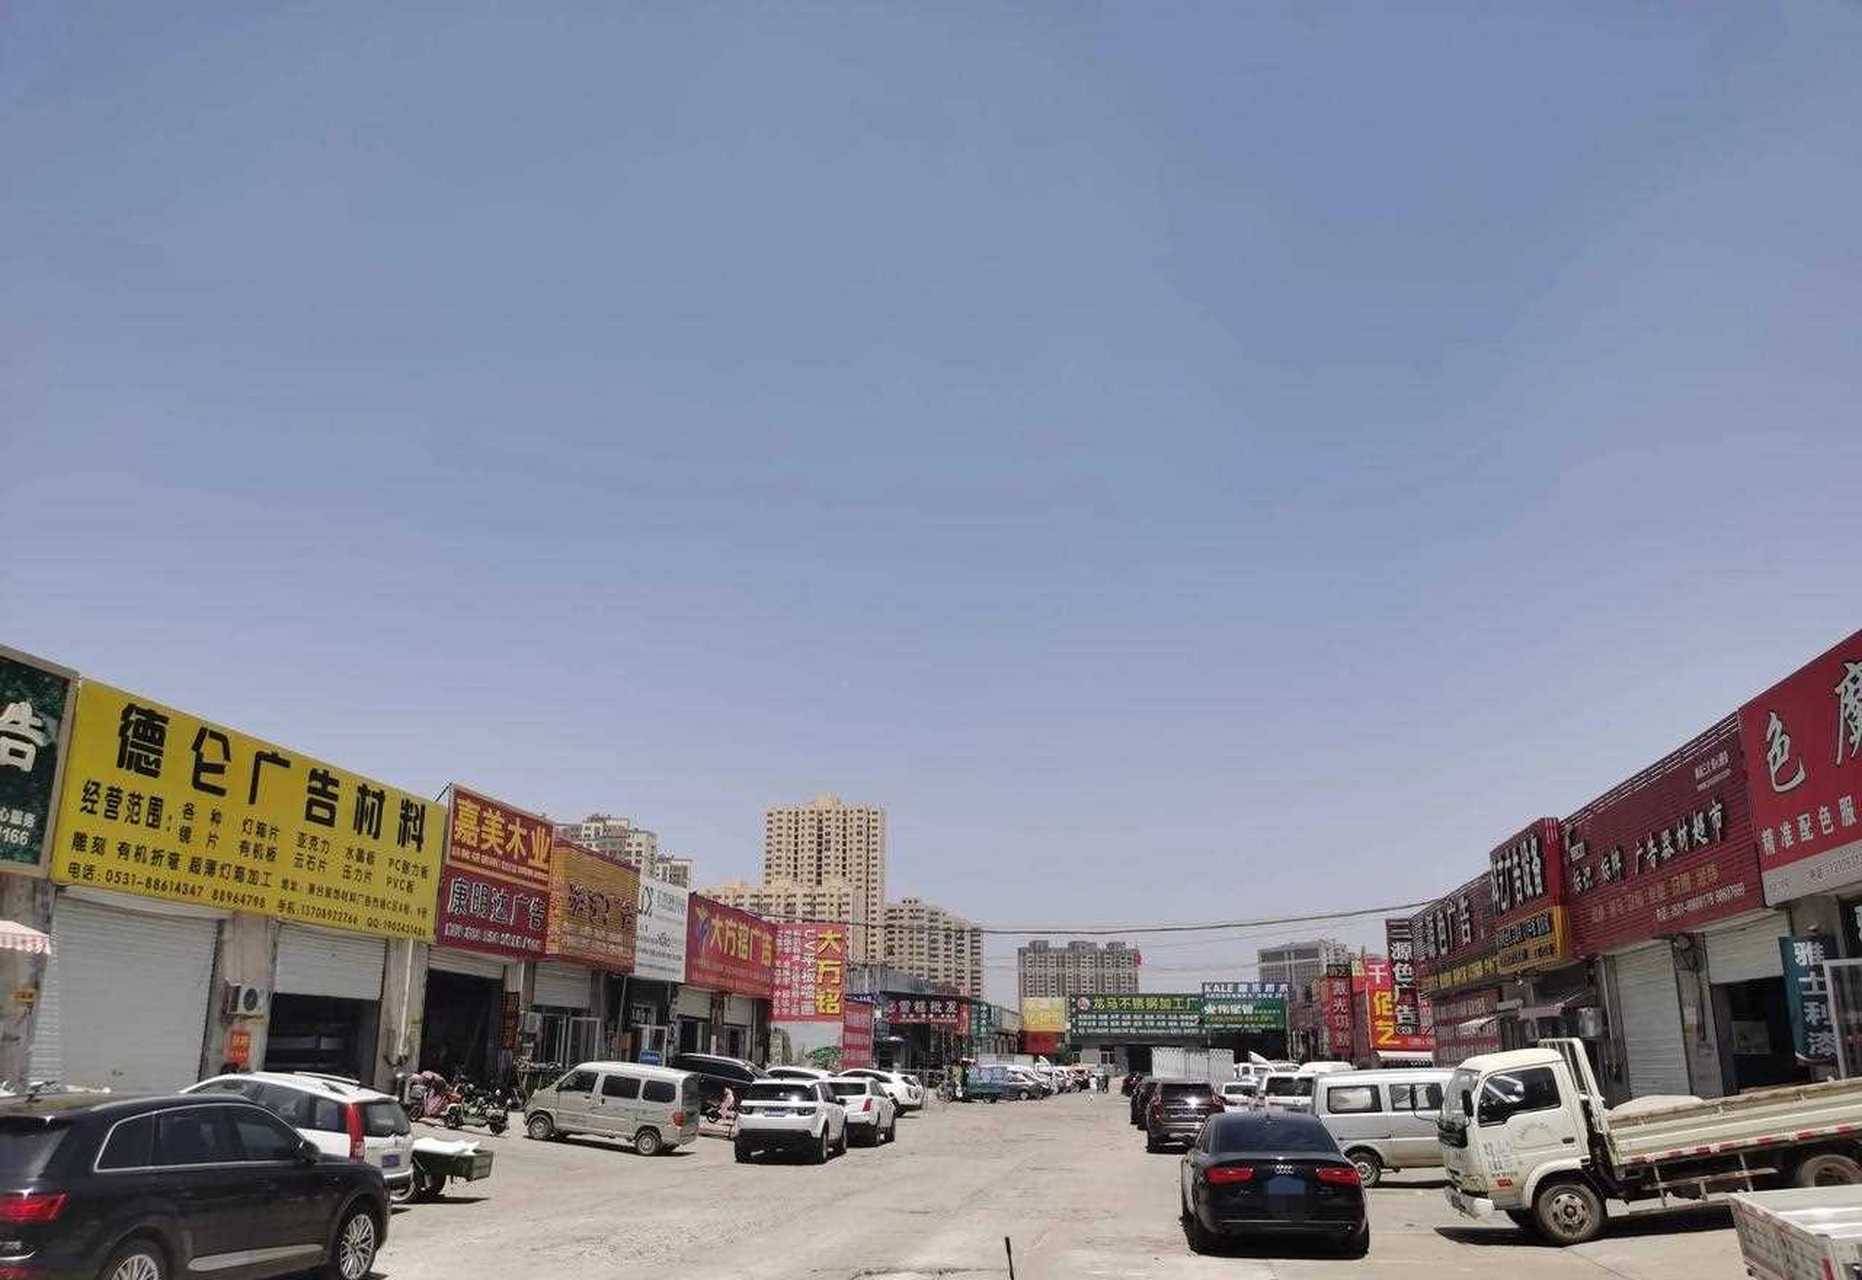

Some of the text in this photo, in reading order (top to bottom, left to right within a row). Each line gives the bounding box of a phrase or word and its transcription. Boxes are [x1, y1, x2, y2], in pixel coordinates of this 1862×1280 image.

[116, 702, 427, 854] 德仑广告材料
[453, 797, 551, 868] 嘉美木业
